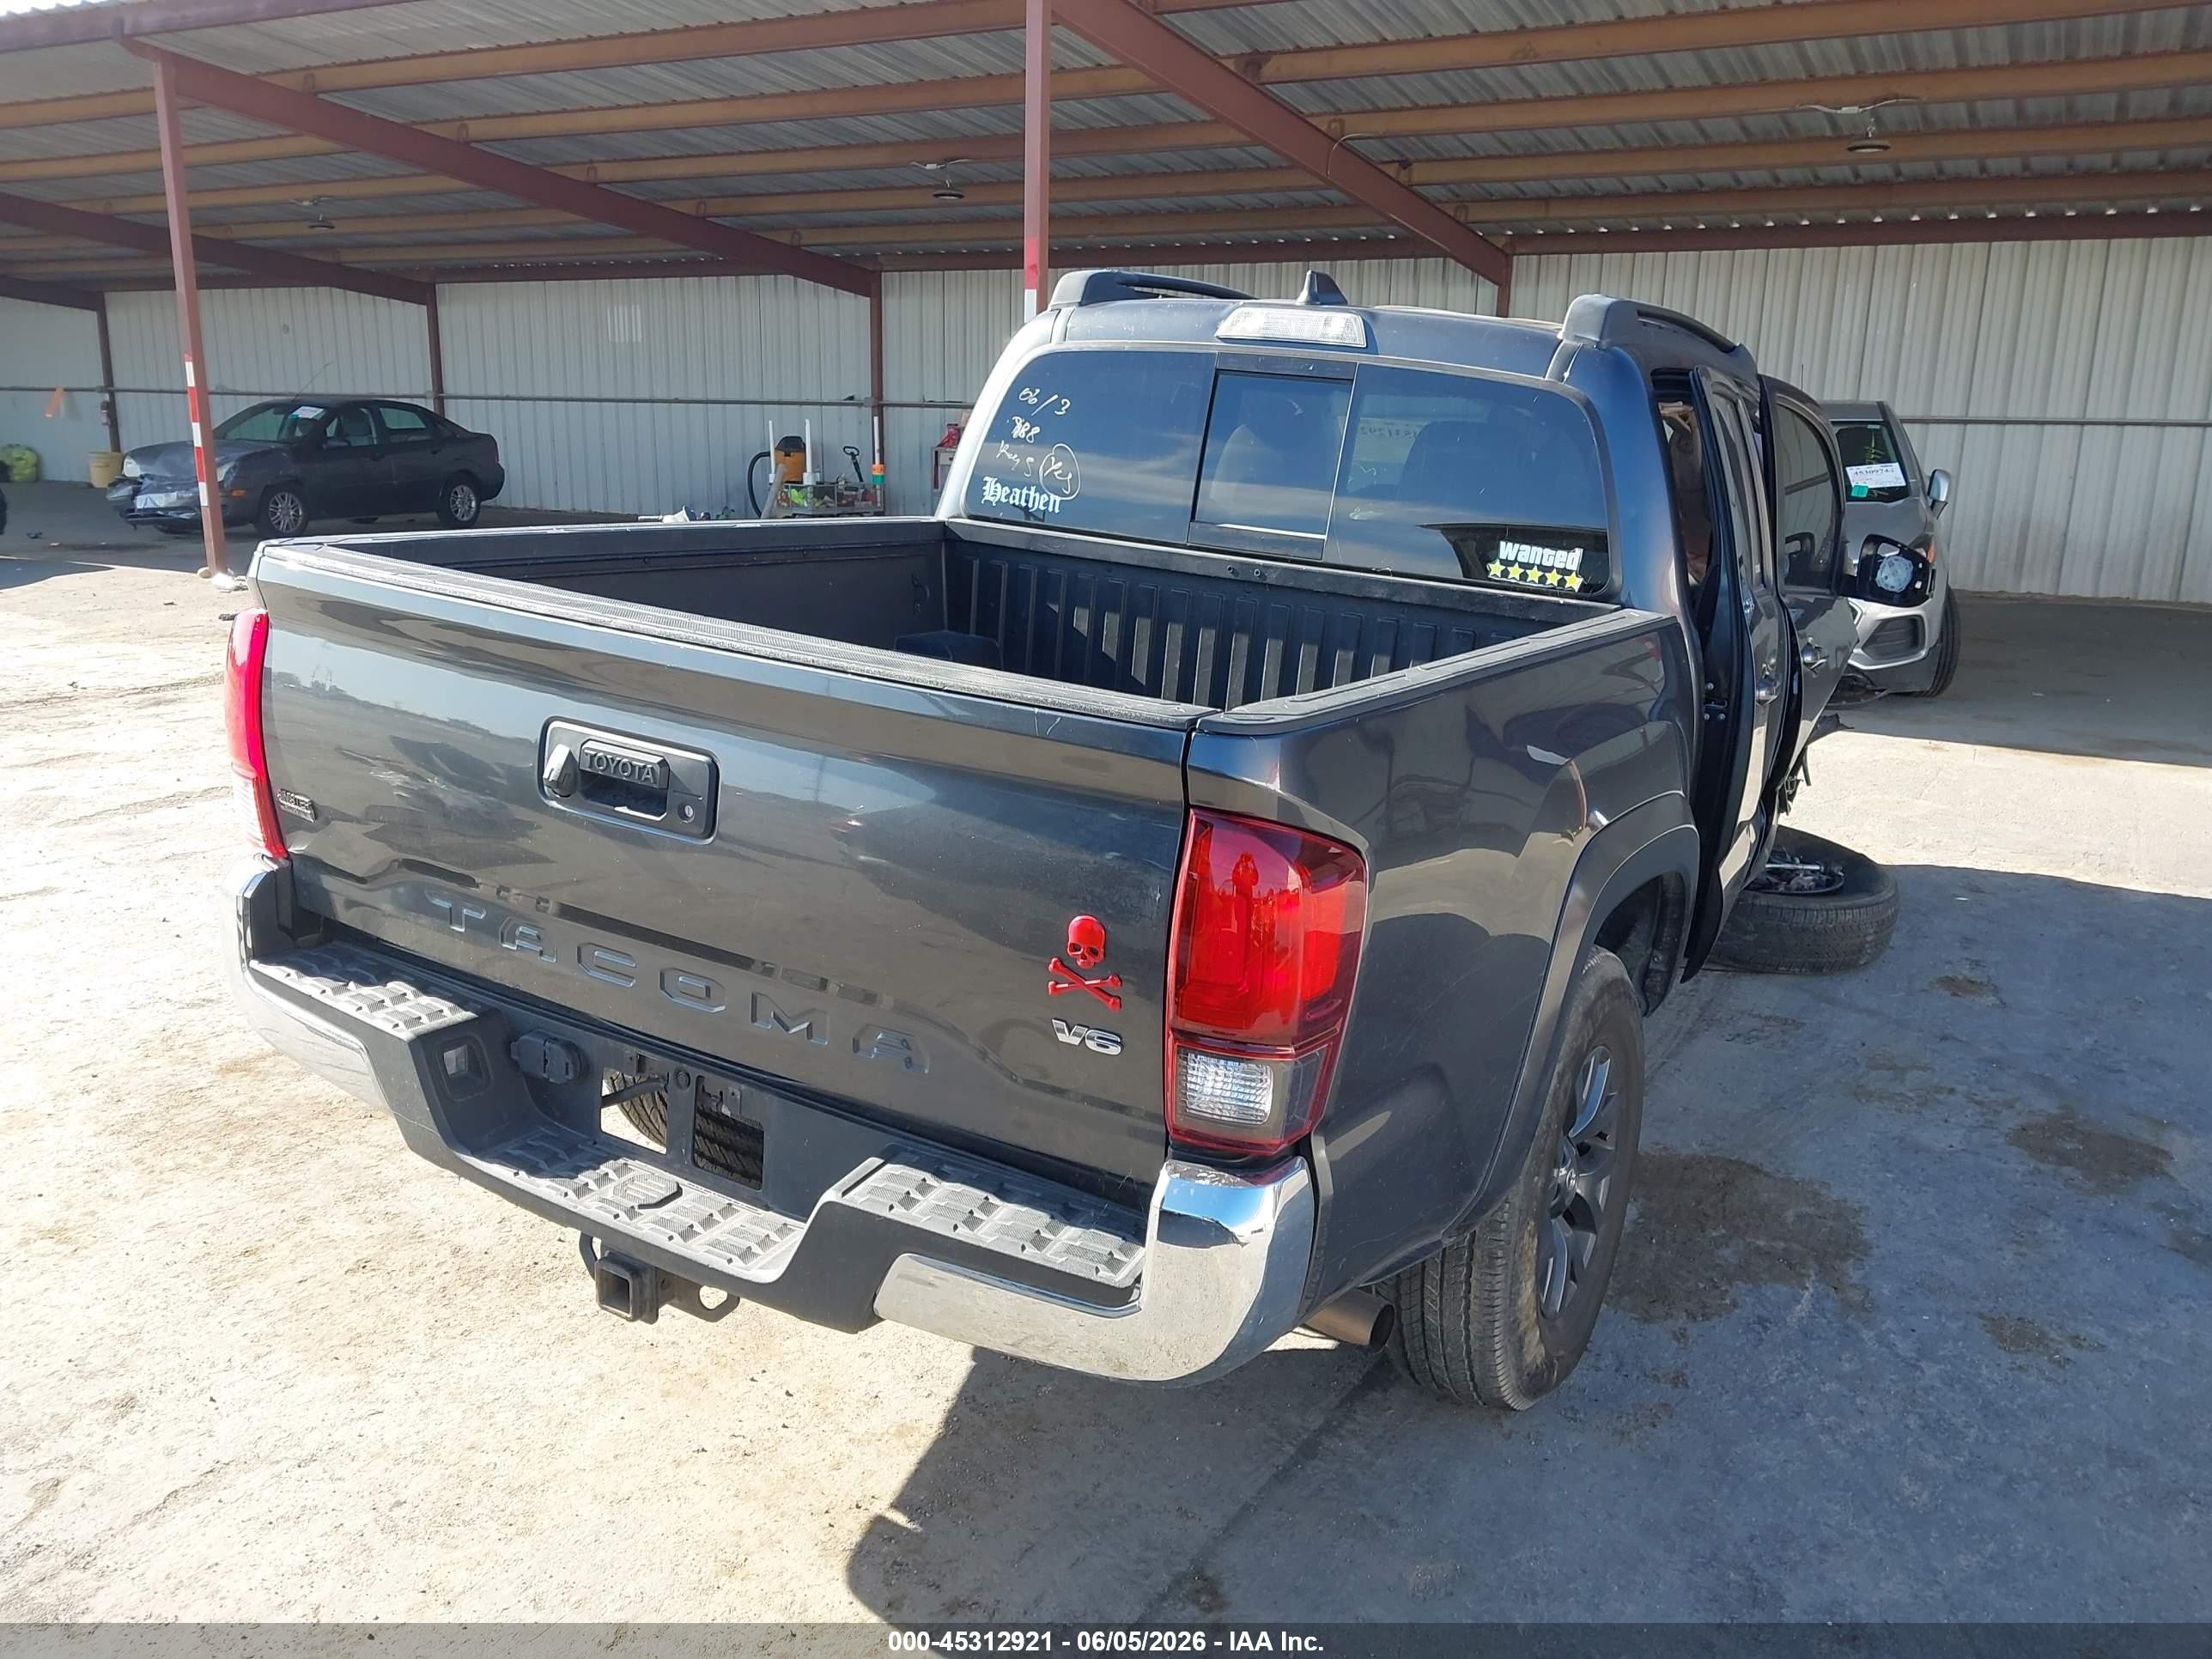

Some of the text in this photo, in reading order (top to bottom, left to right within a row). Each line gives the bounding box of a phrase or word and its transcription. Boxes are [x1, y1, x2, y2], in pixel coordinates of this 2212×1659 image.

[981, 476, 1062, 514] Heathen
[583, 748, 655, 785] TOYOTA
[424, 887, 930, 1074] TACOMA
[1051, 1018, 1124, 1055] V6
